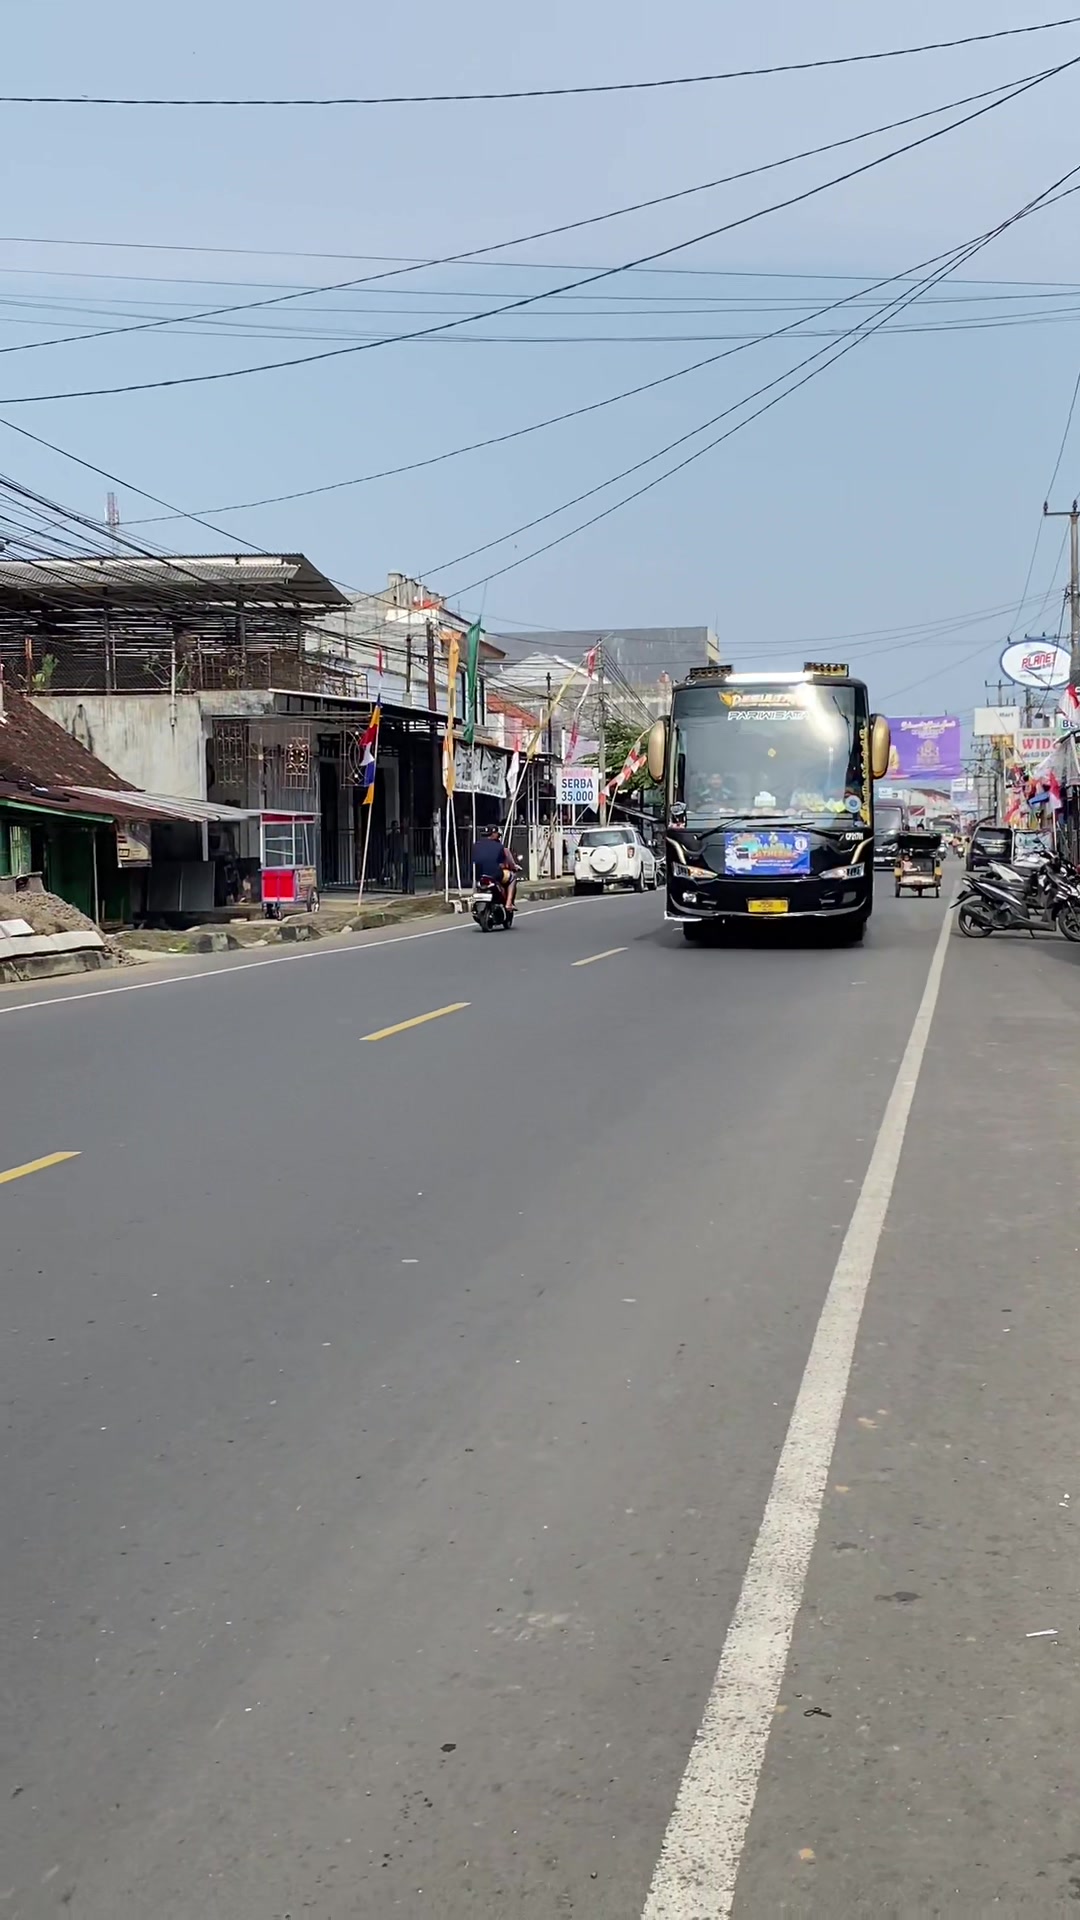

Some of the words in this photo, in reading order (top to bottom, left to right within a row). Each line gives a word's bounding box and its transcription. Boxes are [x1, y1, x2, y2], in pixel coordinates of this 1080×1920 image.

[1021, 651, 1057, 669] PLANET
[728, 710, 808, 721] PARIWISATA
[561, 778, 593, 789] SERBA
[561, 791, 594, 802] 35.000
